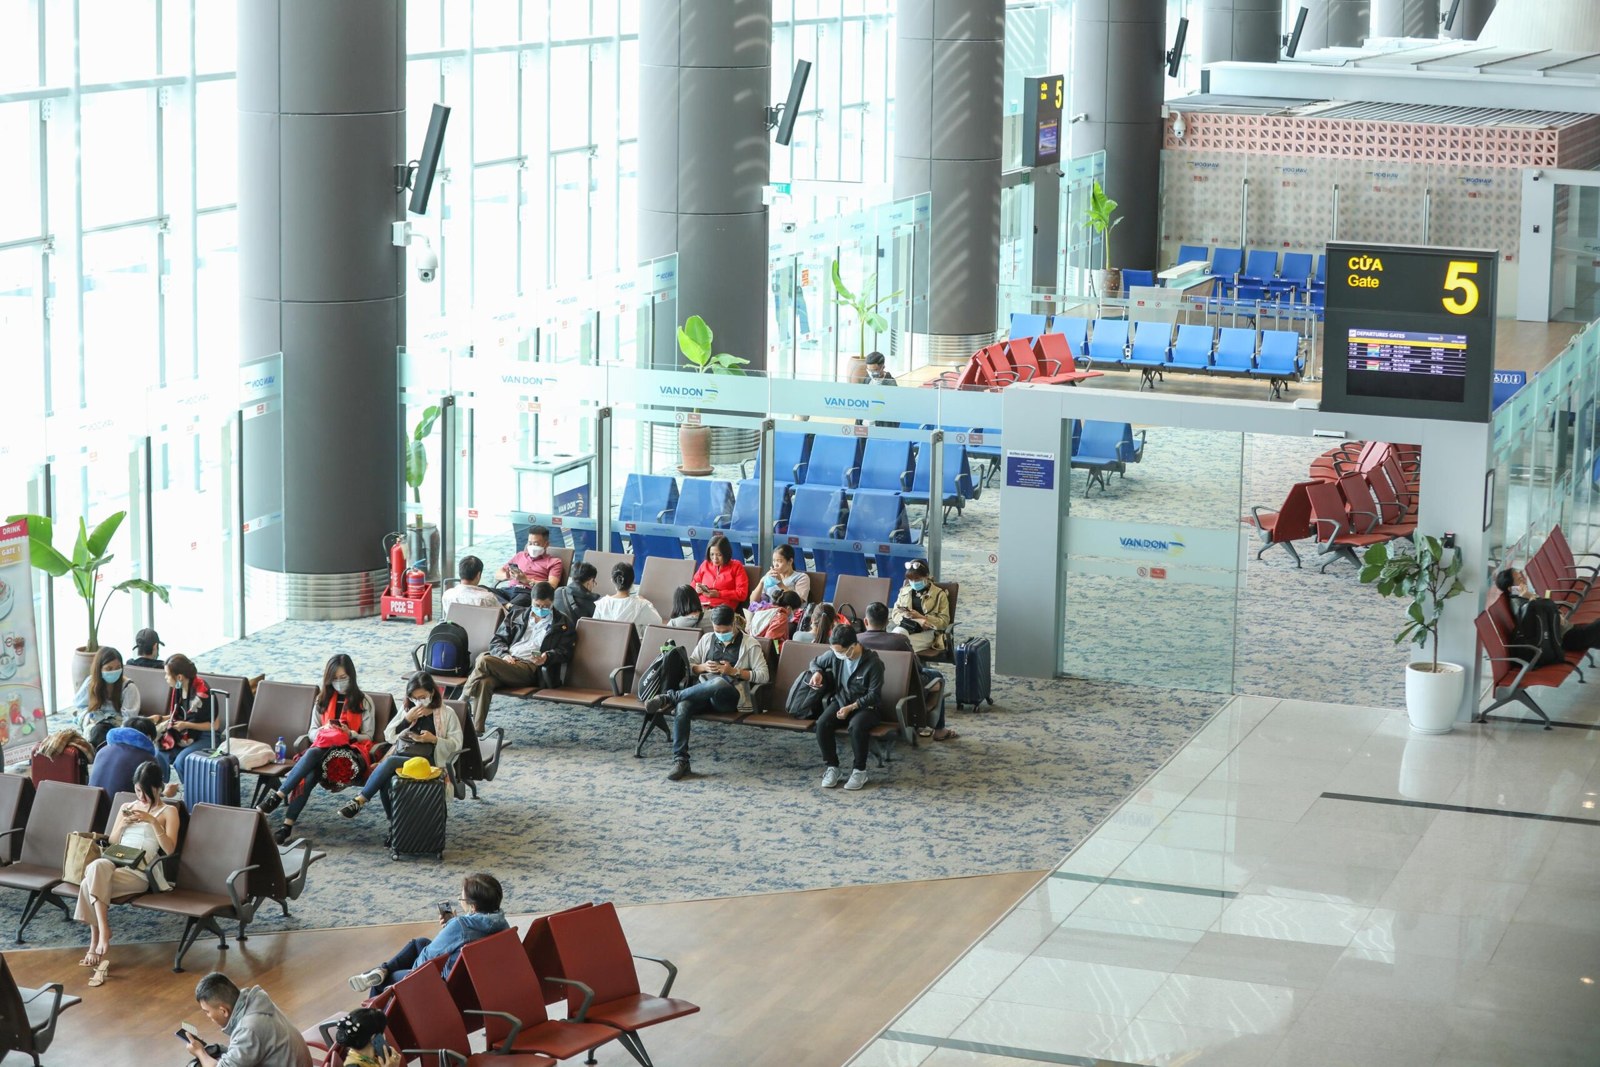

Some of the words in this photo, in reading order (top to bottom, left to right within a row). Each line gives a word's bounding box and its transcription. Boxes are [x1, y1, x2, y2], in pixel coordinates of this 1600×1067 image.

[1055, 80, 1062, 109] 5
[1348, 274, 1380, 288] Gate
[1348, 255, 1383, 271] CỬA
[1442, 261, 1479, 315] 5
[501, 375, 522, 384] VAN
[522, 376, 543, 386] DON
[660, 385, 681, 396] VAN
[682, 386, 703, 397] DON
[824, 396, 846, 407] VAN
[847, 398, 869, 408] DON
[3, 525, 21, 535] DRINK
[1119, 537, 1142, 547] VAN
[1143, 539, 1168, 550] DON
